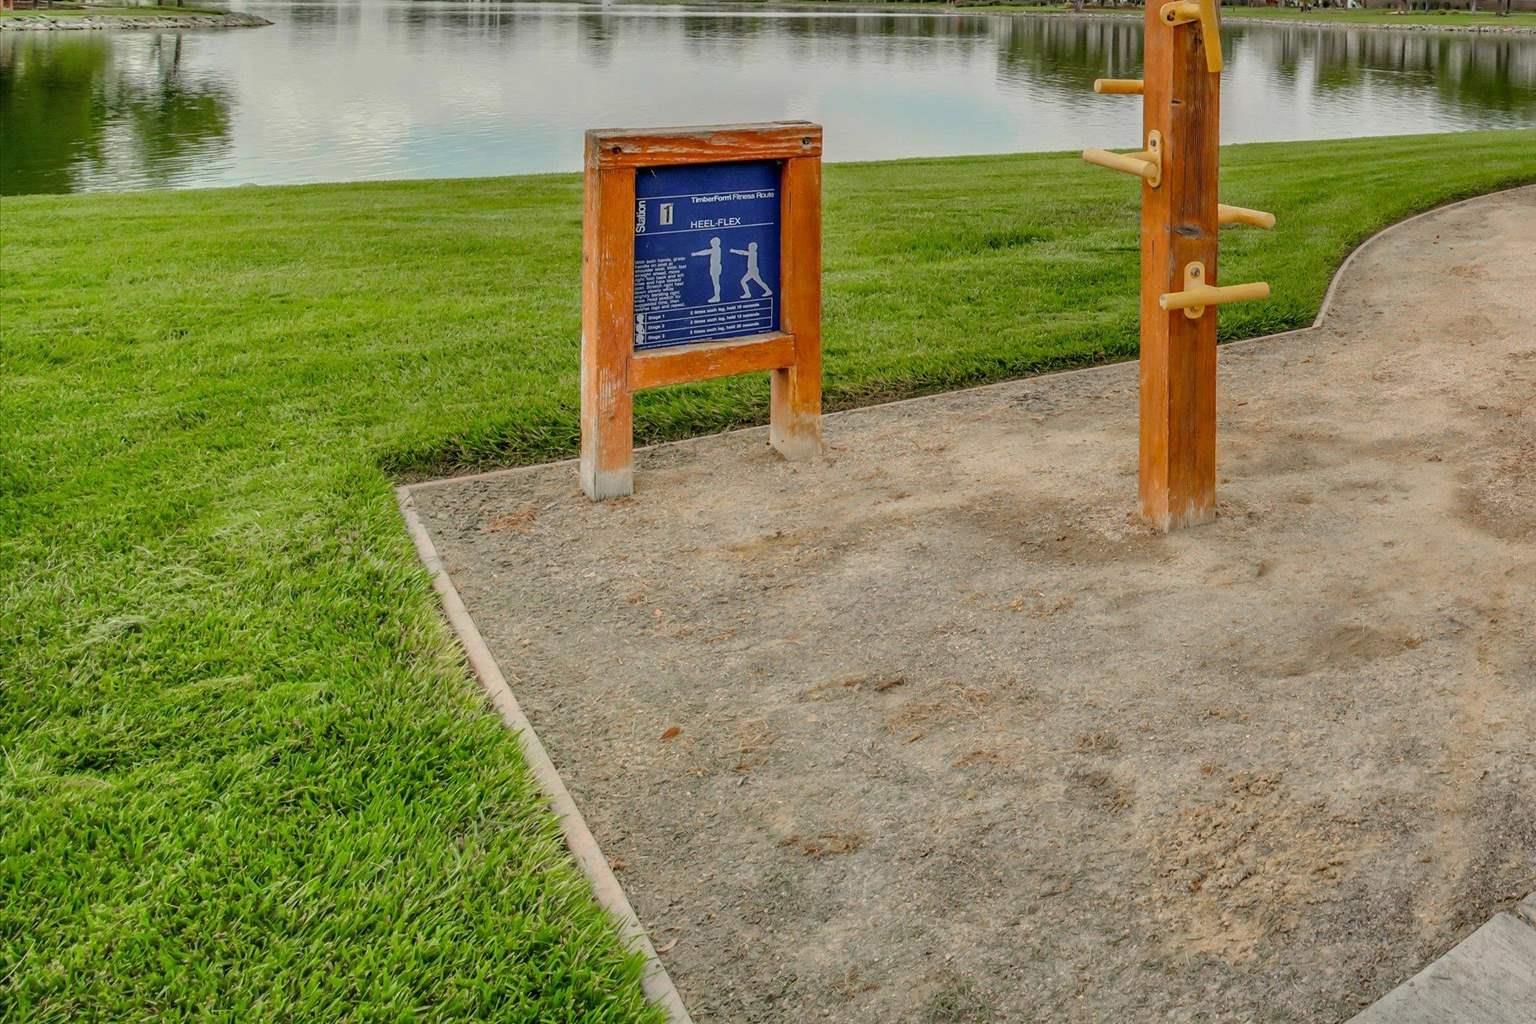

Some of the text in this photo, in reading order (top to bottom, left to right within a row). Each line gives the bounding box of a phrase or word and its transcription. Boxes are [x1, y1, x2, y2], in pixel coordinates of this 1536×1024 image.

[732, 193, 755, 201] Fitness
[635, 200, 647, 233] Station
[663, 205, 671, 224] 1
[690, 217, 741, 228] HEEL-FLEX
